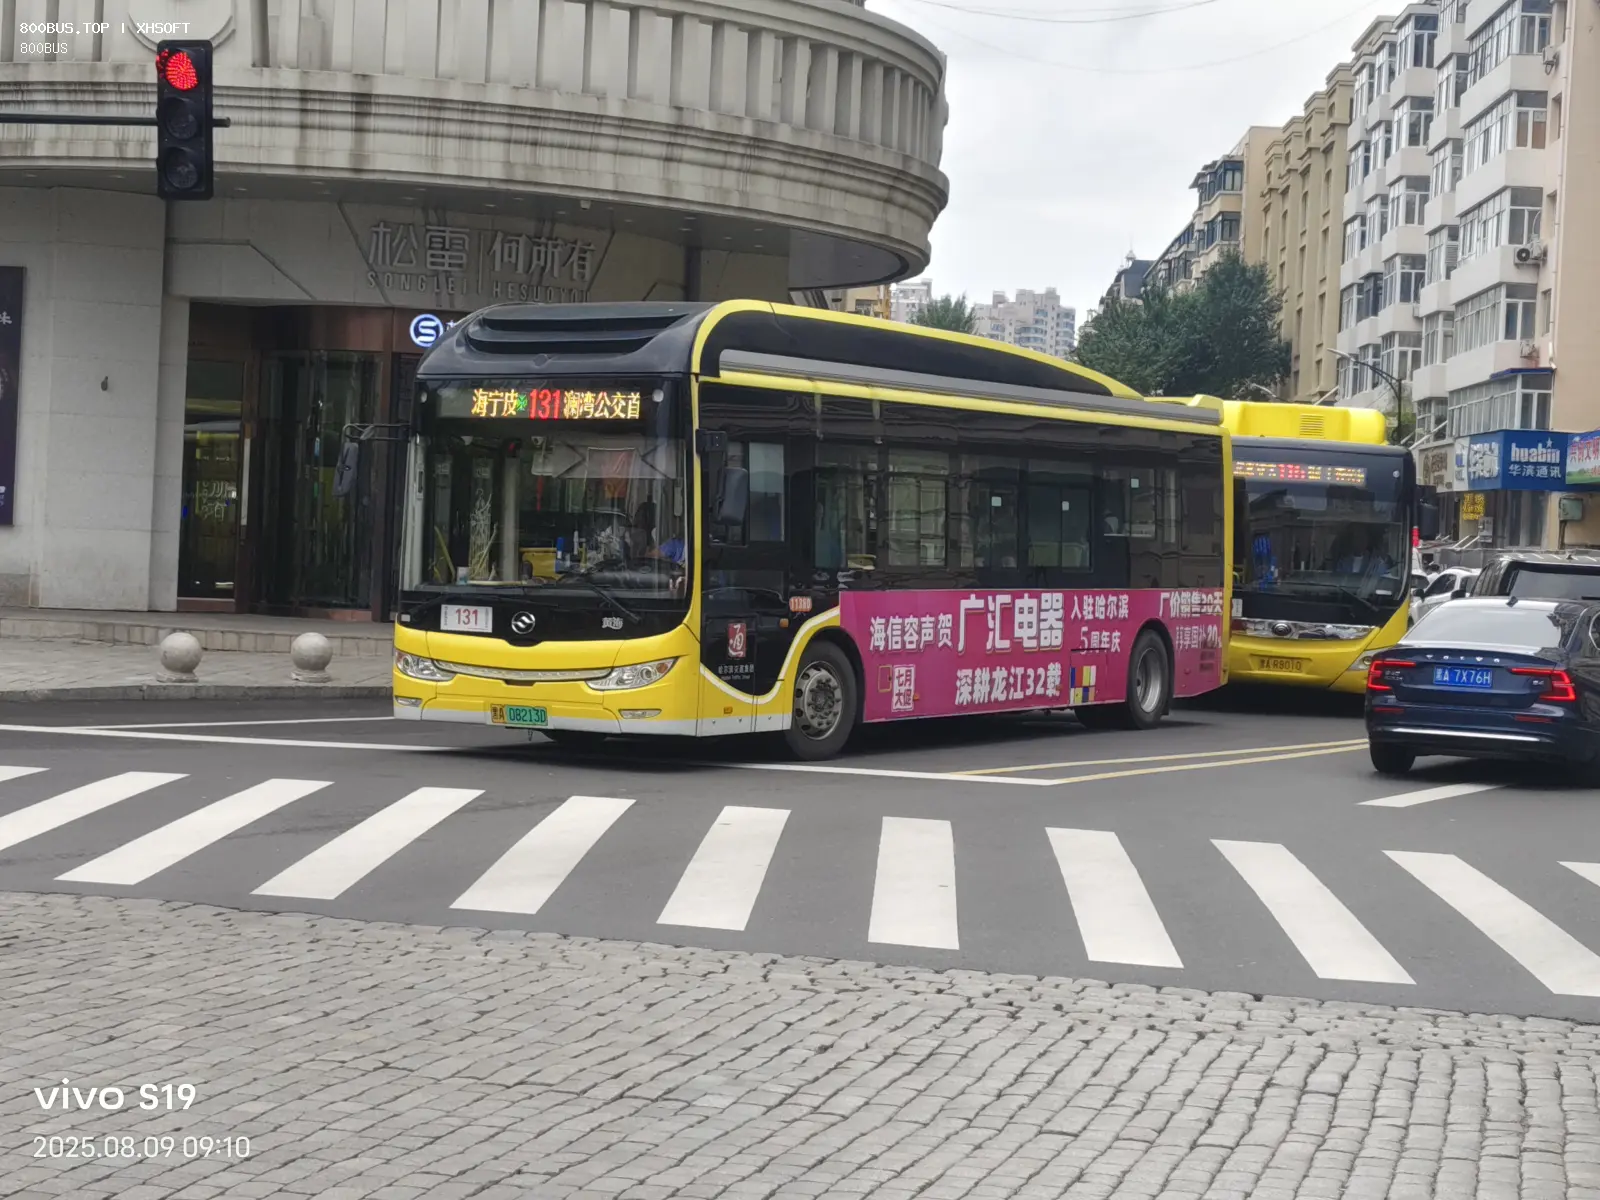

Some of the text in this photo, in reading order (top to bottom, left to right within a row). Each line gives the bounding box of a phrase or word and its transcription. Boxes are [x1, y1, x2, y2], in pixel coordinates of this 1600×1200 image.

[368, 222, 597, 283] 松雷 何所有
[367, 271, 467, 295] SONGLEI
[471, 388, 641, 420] 海宁皮 131 澜湾公交首
[1511, 438, 1560, 464] huabin
[456, 608, 478, 626] 131
[958, 593, 1064, 653] 广汇电器
[1070, 594, 1129, 620] 入驻哈尔滨
[869, 613, 953, 651] 海信容声贺
[955, 662, 1062, 705] 深耕龙江32载
